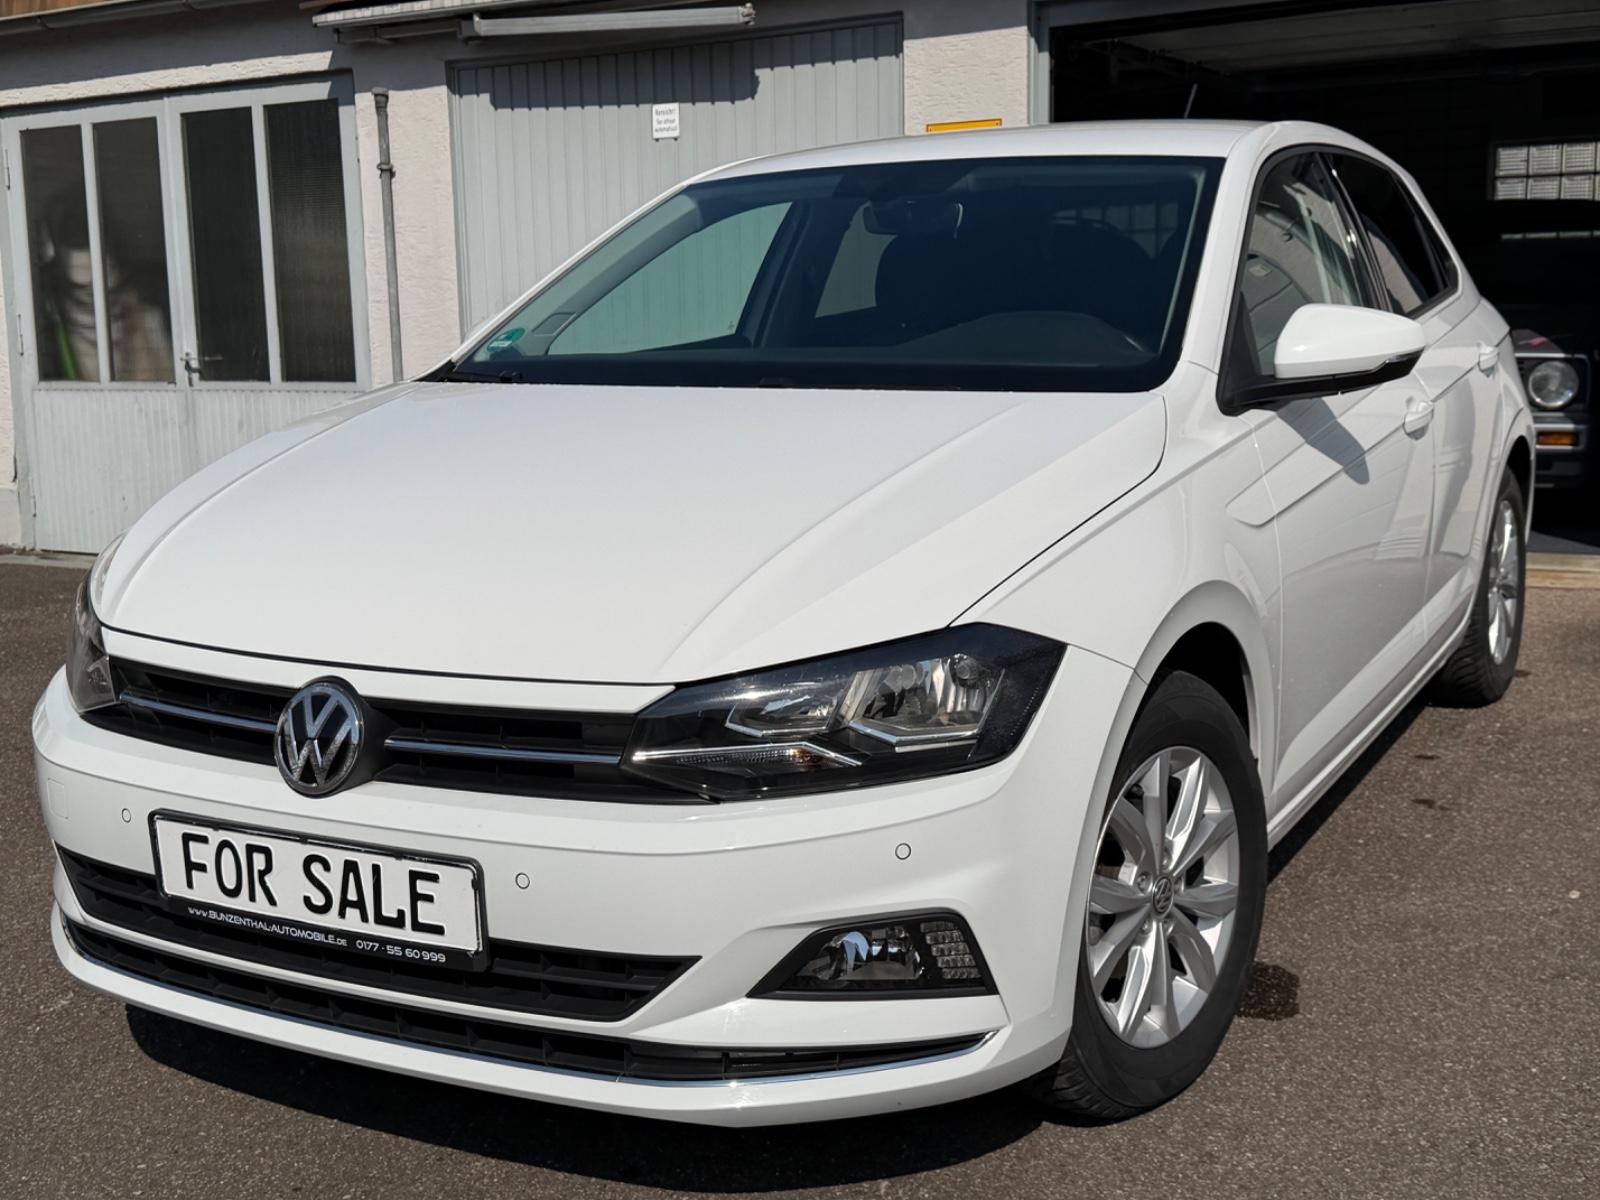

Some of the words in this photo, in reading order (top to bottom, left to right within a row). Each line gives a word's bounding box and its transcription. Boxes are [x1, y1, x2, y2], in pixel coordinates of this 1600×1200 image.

[280, 684, 361, 791] VW
[181, 832, 278, 907] FOR
[302, 853, 446, 936] SALE
[355, 939, 379, 952] 0177
[386, 945, 403, 956] 55
[405, 948, 420, 959] 60
[421, 951, 446, 962] 999
